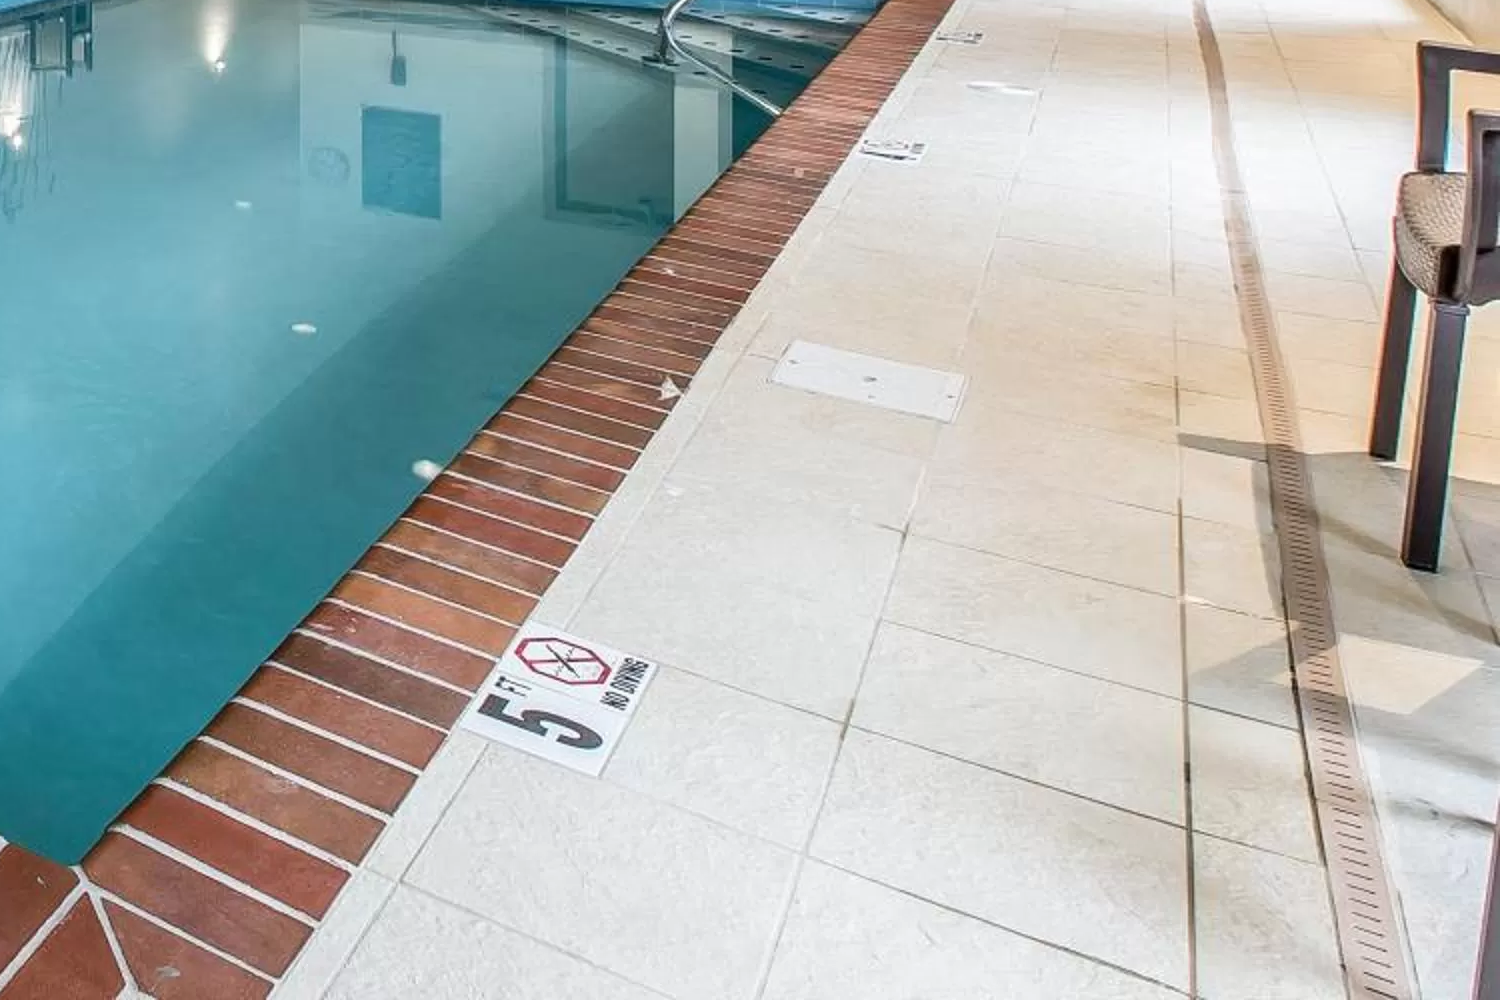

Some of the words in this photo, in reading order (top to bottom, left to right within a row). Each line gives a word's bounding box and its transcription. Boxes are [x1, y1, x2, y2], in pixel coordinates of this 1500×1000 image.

[493, 675, 533, 697] FT
[610, 656, 650, 695] DIVING
[599, 690, 631, 711] NO
[478, 693, 603, 750] 5
